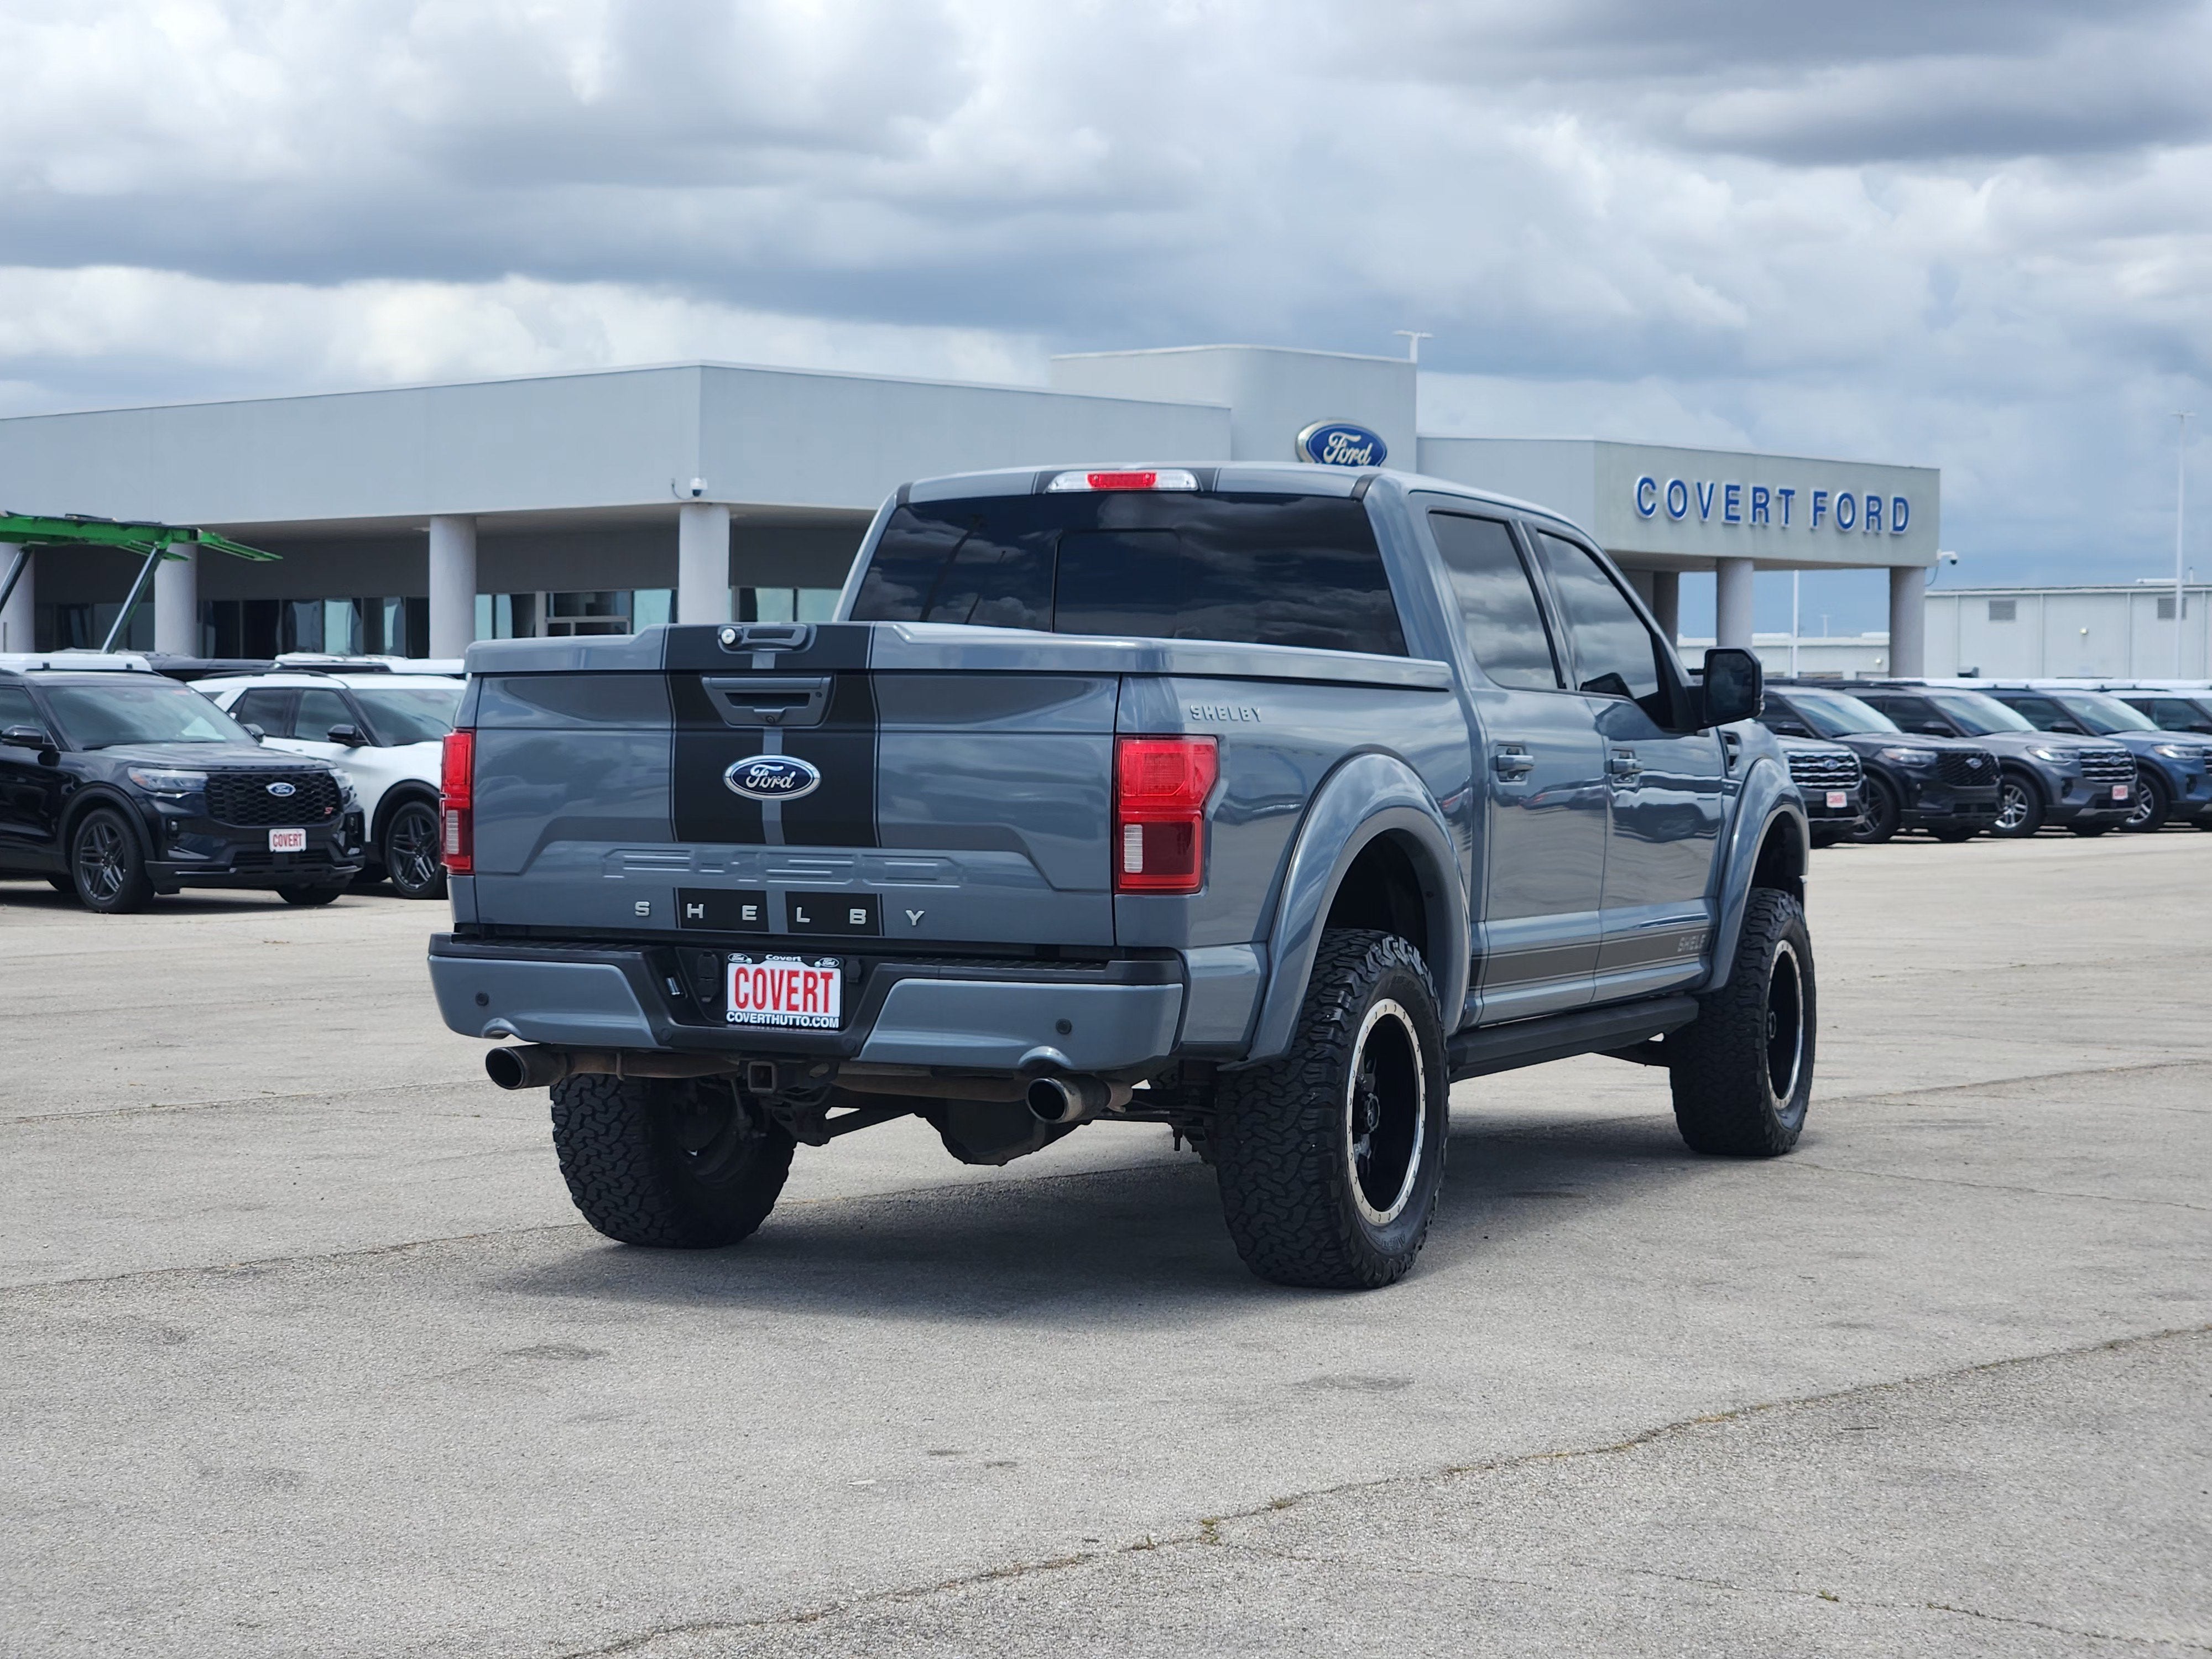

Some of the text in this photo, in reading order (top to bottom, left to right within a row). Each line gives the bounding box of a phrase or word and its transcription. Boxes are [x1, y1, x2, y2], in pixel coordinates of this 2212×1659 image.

[1323, 431, 1373, 465] Ford
[1635, 477, 1911, 534] COVERT FORD
[1190, 704, 1261, 722] SHELBY
[745, 764, 795, 789] Ford
[273, 833, 302, 847] COVERT
[635, 901, 925, 926] SHELBY
[735, 967, 834, 1013] COVERT
[726, 1011, 839, 1028] COVERTHUTTO.COM
